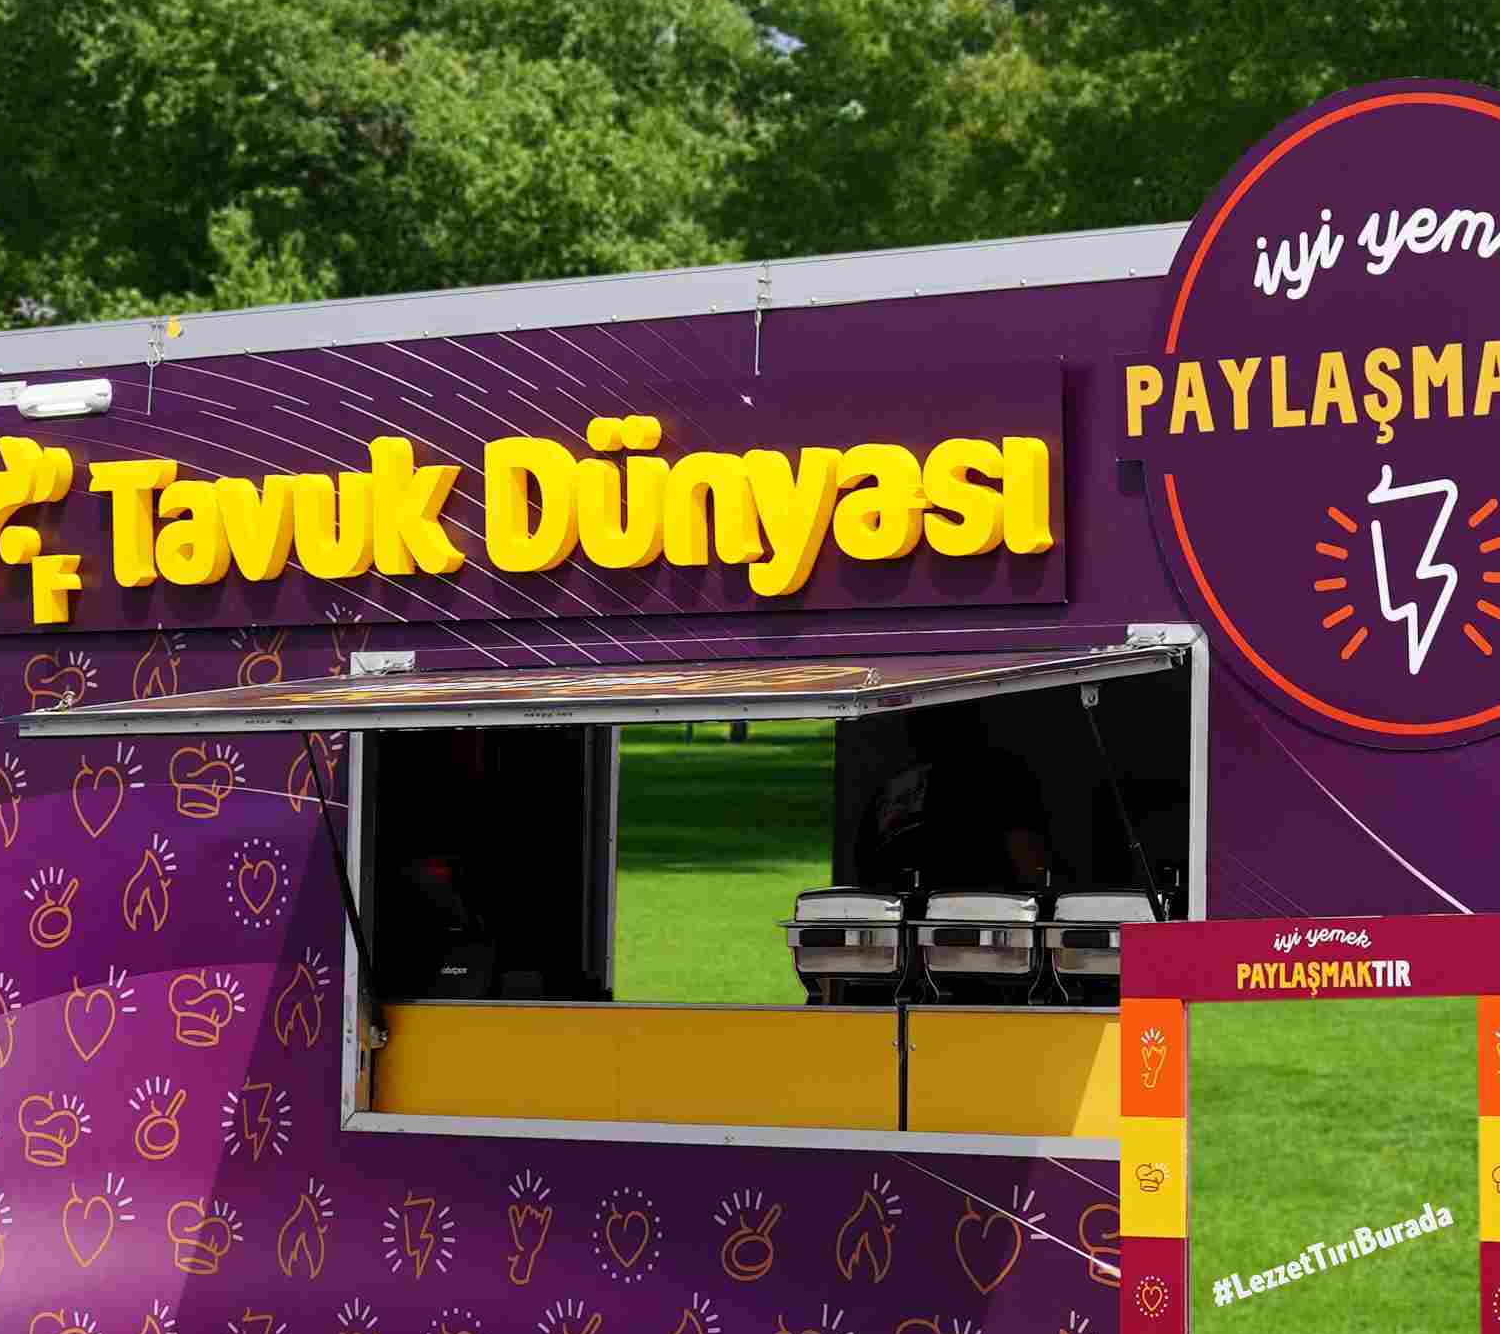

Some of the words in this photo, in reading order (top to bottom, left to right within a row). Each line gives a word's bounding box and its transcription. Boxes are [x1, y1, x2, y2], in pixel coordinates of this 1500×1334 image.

[1252, 208, 1344, 300] iyi
[88, 435, 466, 588] Tavuk
[483, 414, 1054, 597] Dünyası
[1236, 960, 1412, 996] PAYLAŞMAKTIR
[1273, 927, 1301, 953] iyi
[1304, 927, 1372, 949] yemek
[1211, 1201, 1455, 1308] #LezzetTırıBurada
